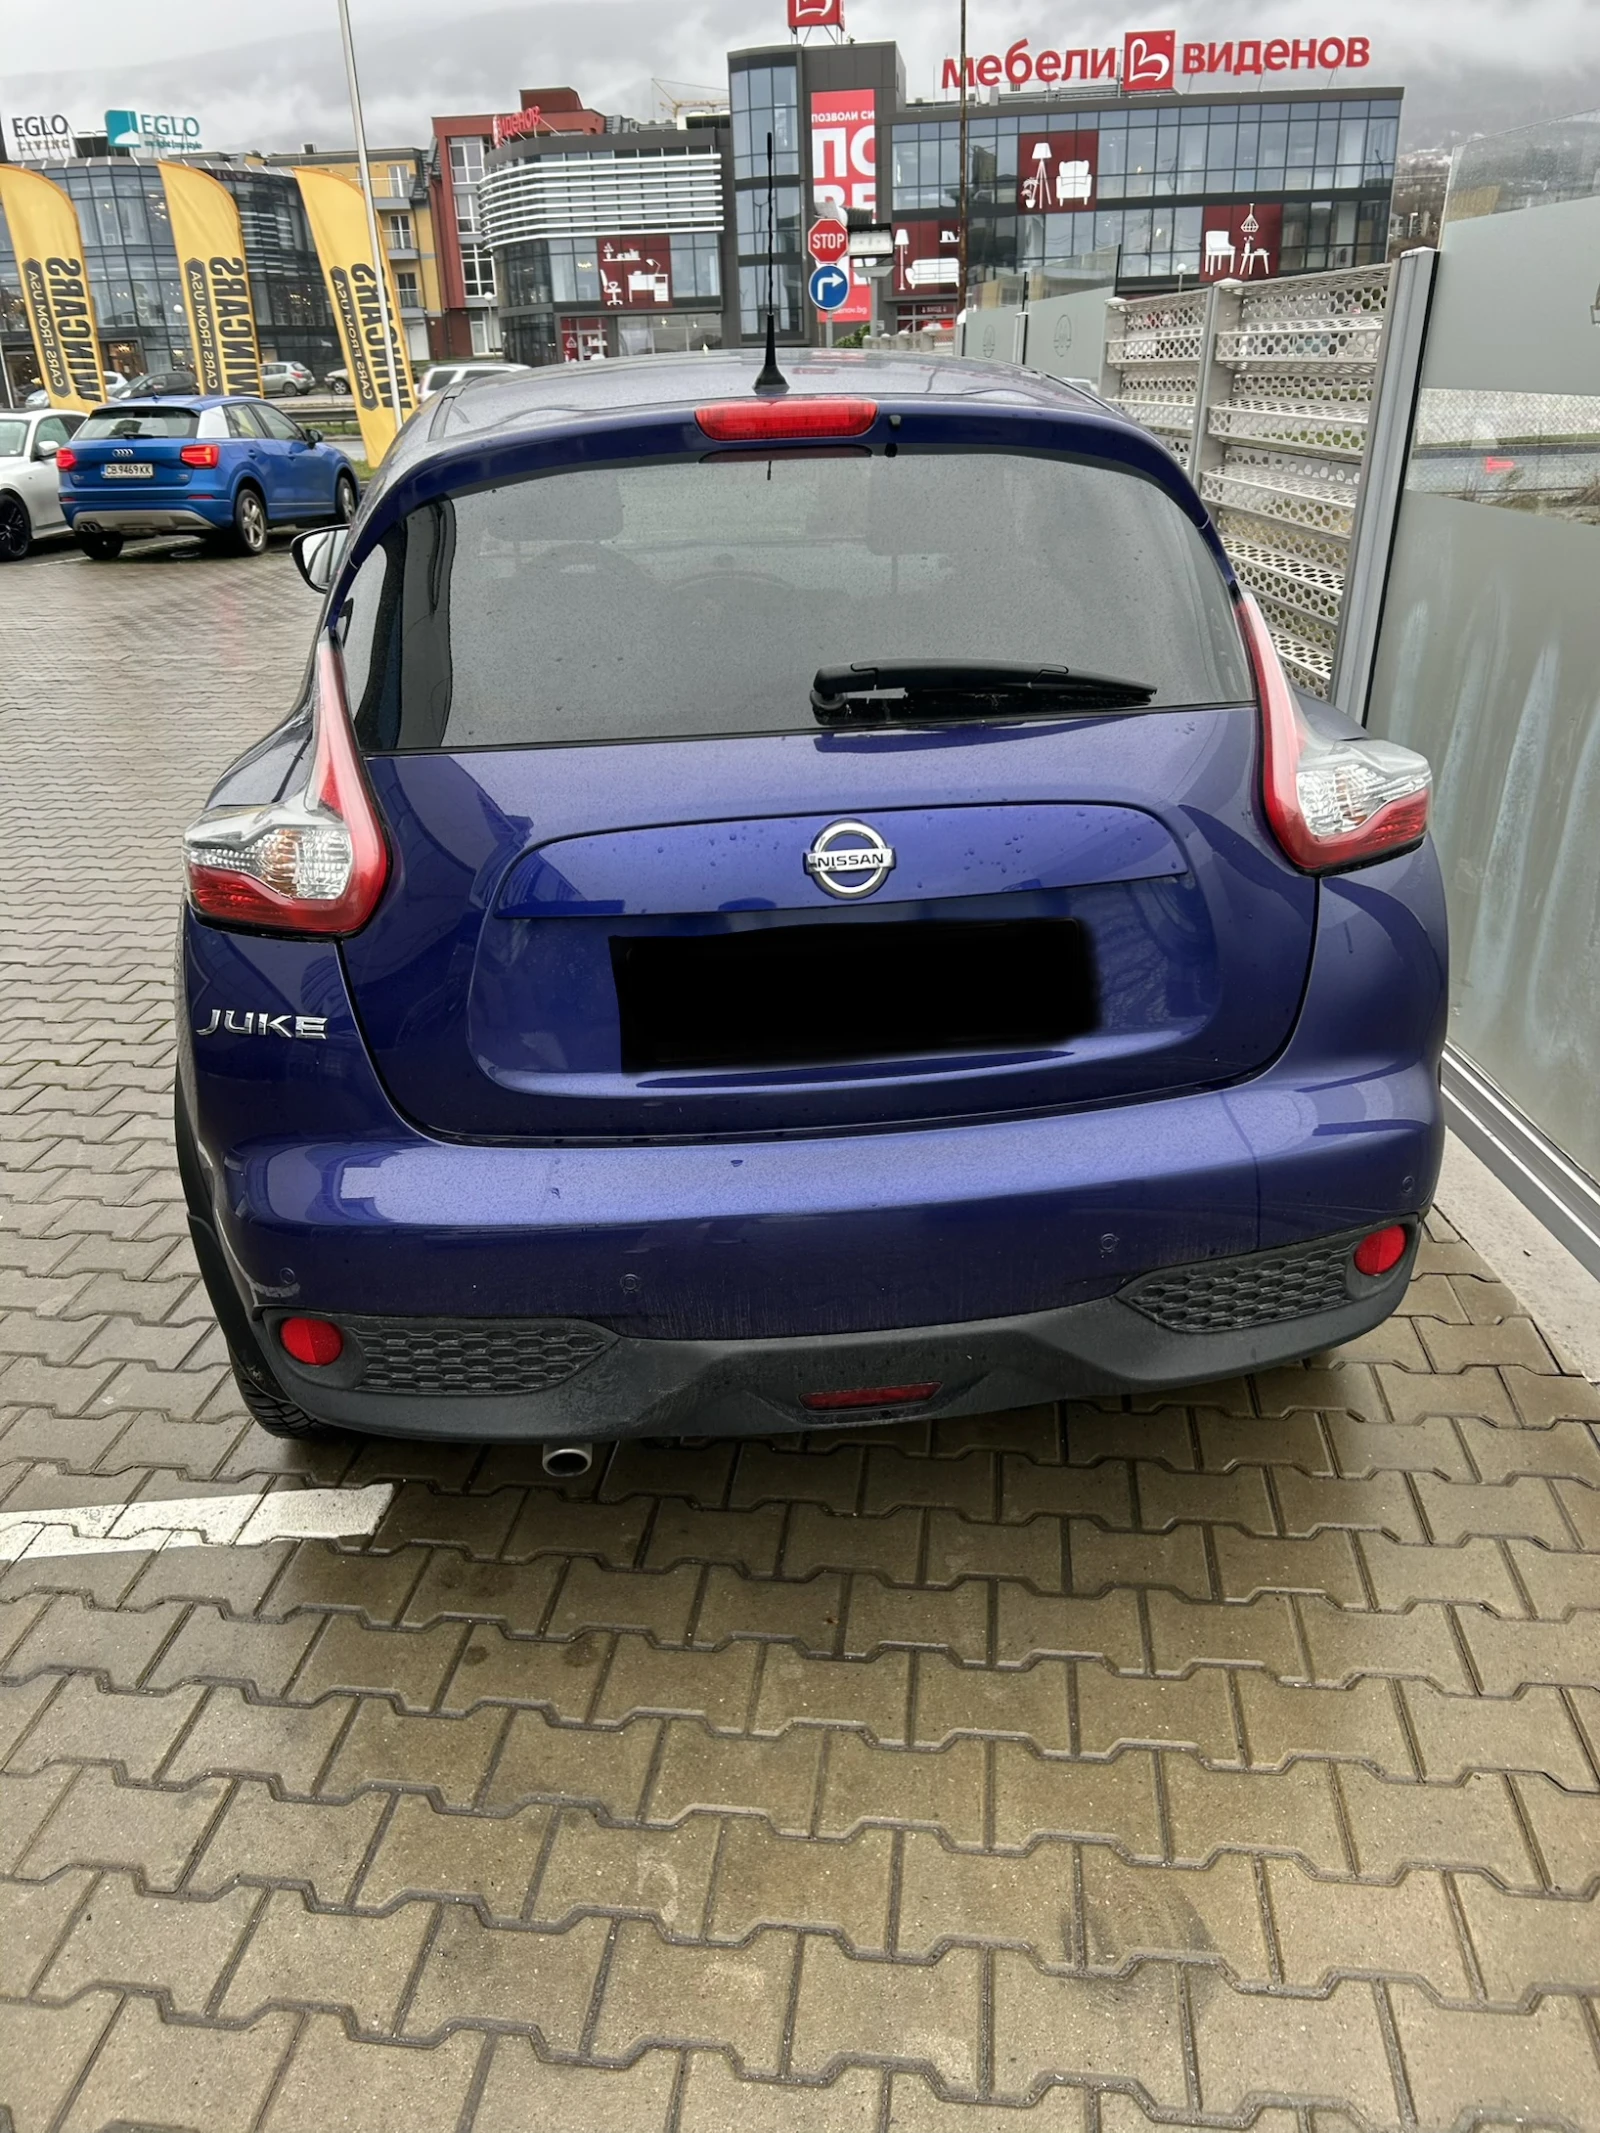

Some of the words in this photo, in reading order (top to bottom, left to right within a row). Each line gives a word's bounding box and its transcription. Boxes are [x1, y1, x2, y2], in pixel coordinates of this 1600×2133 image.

[941, 38, 1116, 88] мебели
[1182, 36, 1371, 74] виденов
[12, 114, 69, 137] EGLO
[141, 114, 200, 137] EGLO
[17, 139, 70, 151] LIVING
[812, 233, 845, 249] STOP
[817, 853, 884, 868] NISSAN
[196, 1009, 328, 1040] JUKE
